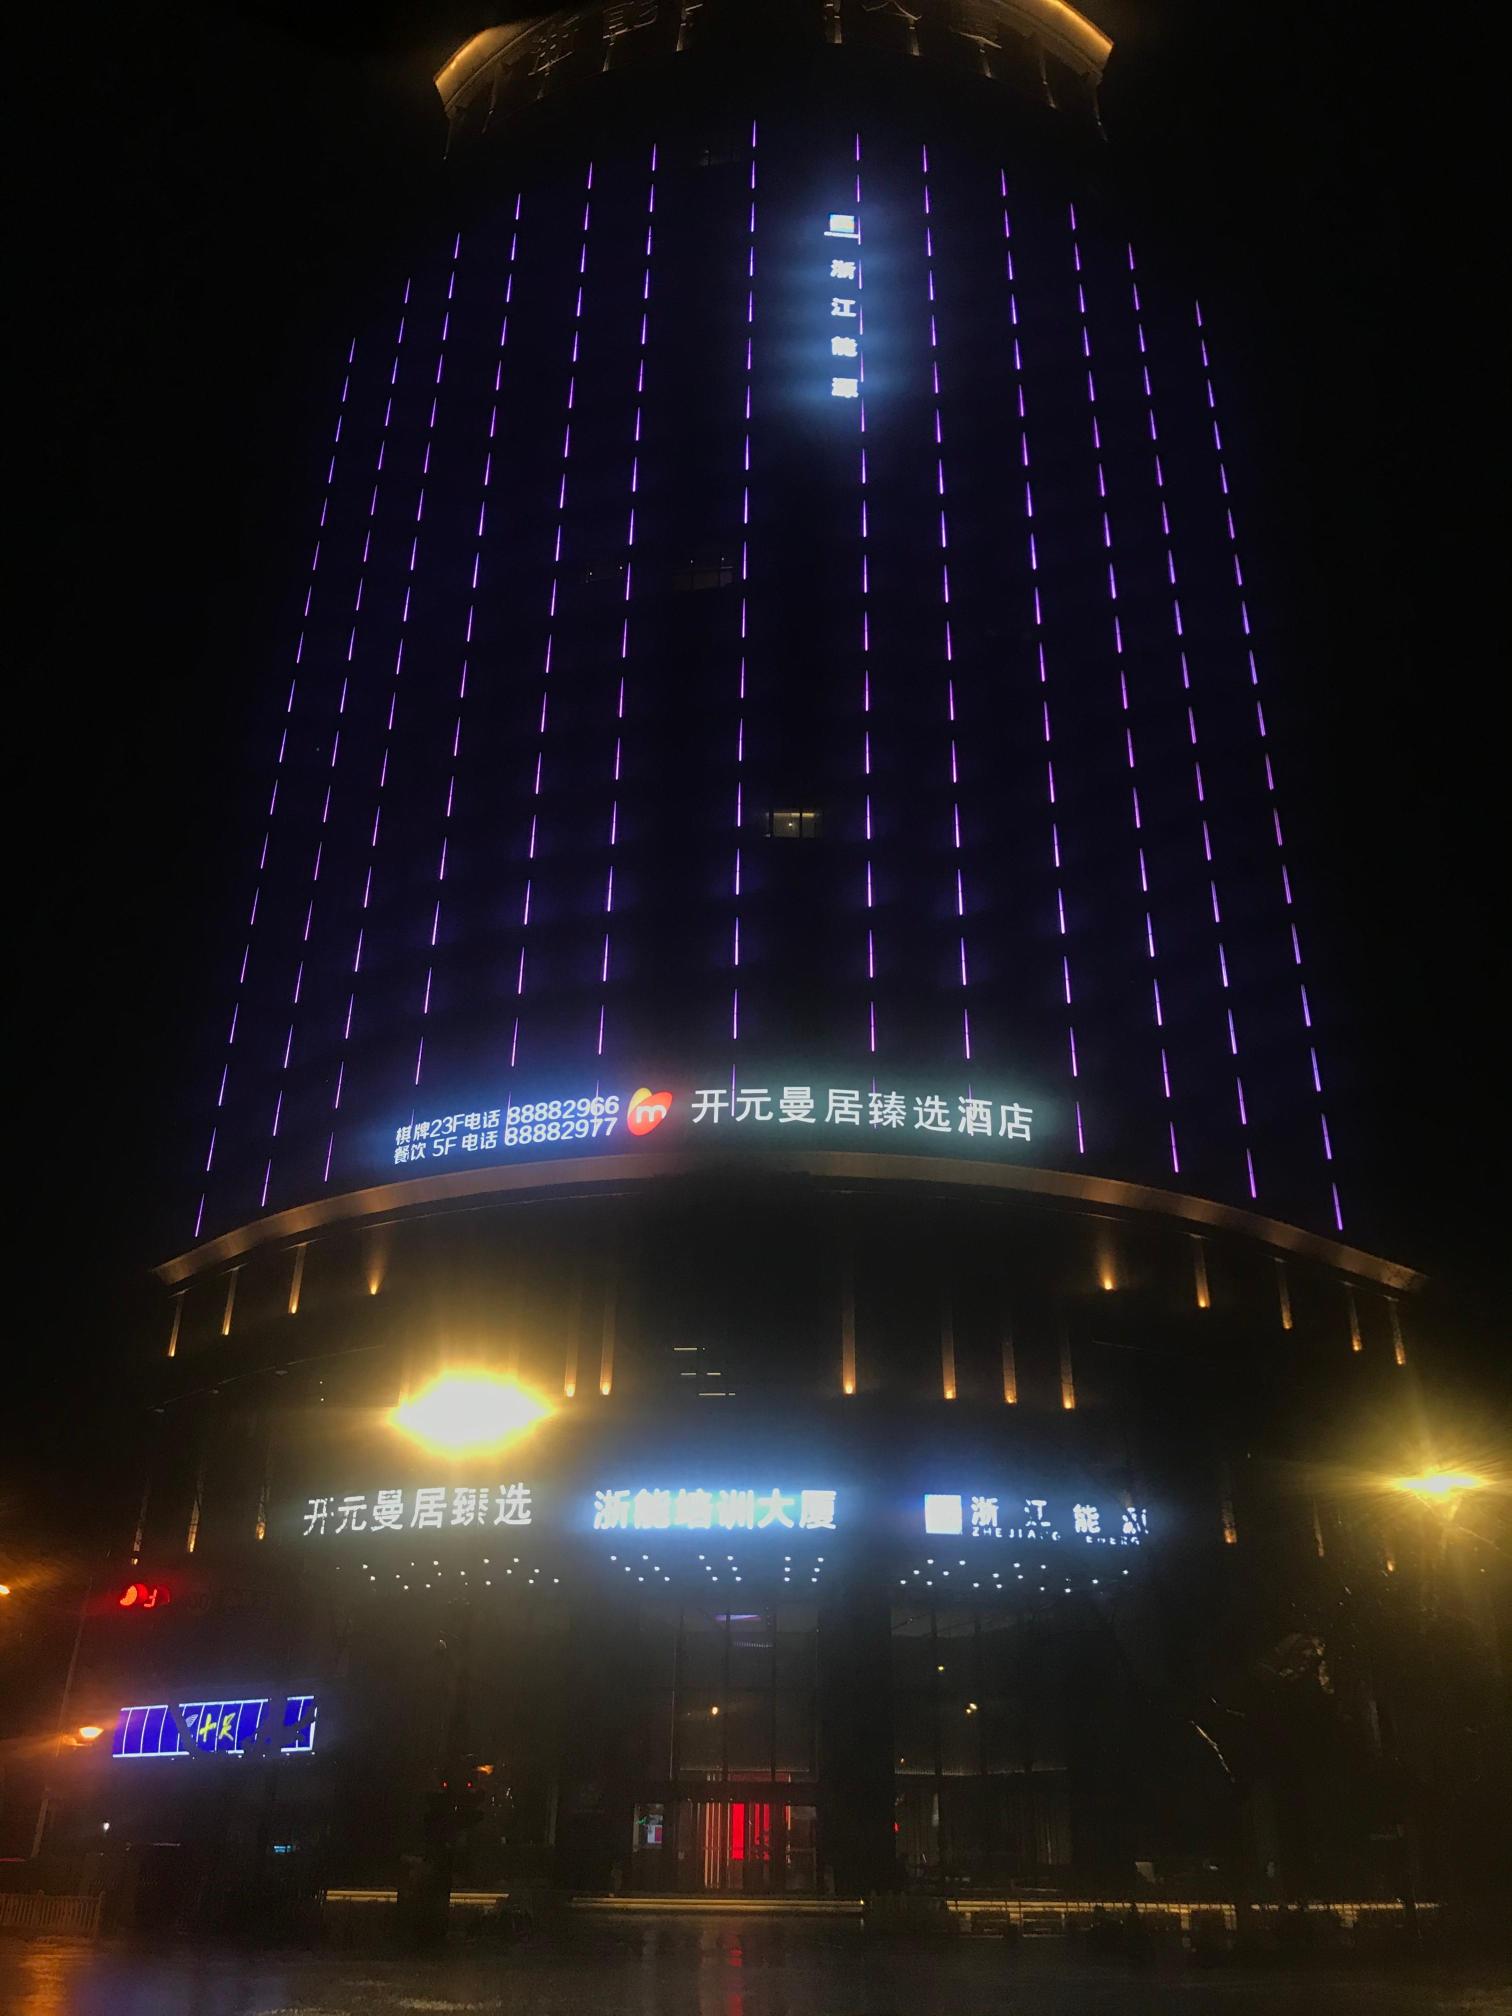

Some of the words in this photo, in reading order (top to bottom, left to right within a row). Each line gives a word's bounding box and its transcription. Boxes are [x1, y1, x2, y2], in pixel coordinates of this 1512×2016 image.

[507, 1096, 620, 1125] 88882966
[691, 1086, 1034, 1142] 开元曼居臻选酒店
[394, 1142, 427, 1165] 餐饮
[432, 1136, 458, 1157] 5F
[461, 1130, 499, 1152] 电话
[504, 1117, 618, 1146] 88882977
[303, 1482, 533, 1536] 开元曼居臻选
[971, 1526, 1062, 1542] ZHEJIAG
